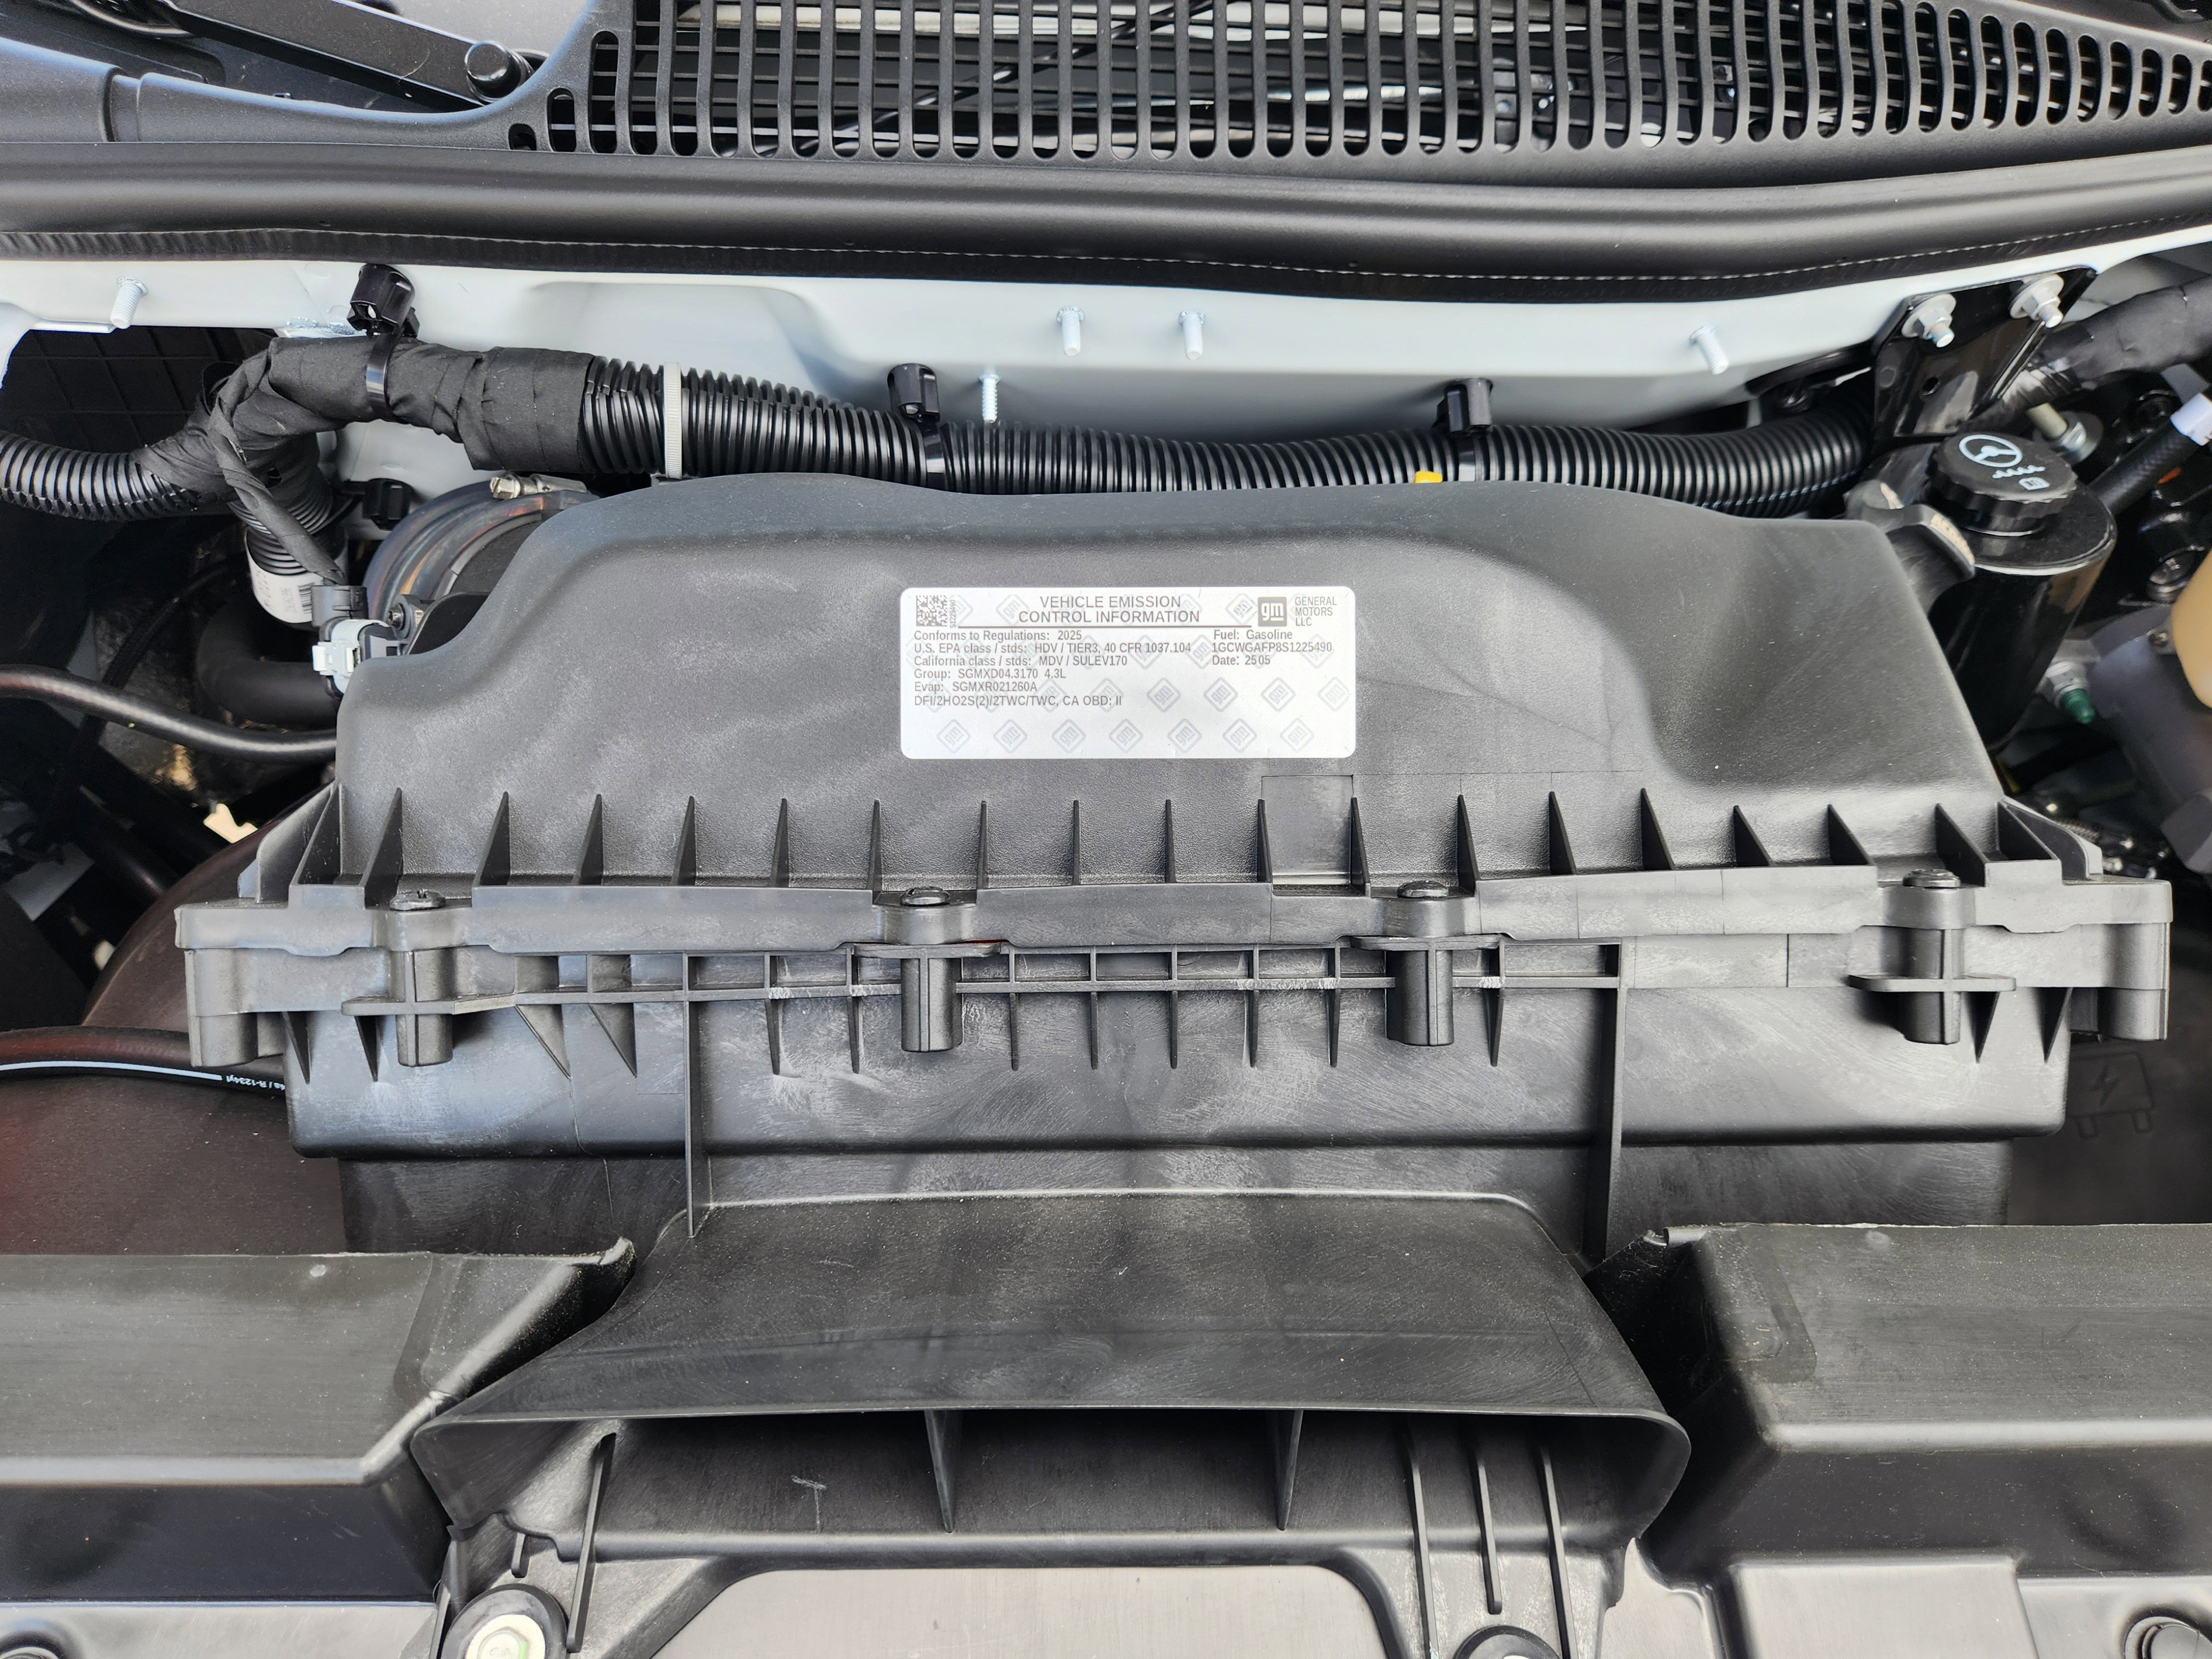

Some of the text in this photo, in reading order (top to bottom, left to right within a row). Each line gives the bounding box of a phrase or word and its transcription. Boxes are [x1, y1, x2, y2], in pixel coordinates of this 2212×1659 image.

[1040, 596, 1181, 608] VEHICLE EMISSION
[1295, 596, 1337, 606] GENERAL
[1019, 611, 1199, 623] CONTROL INFORMATION
[1295, 607, 1333, 616] MOTORS
[1295, 617, 1312, 627] LLC
[914, 630, 1082, 643] Conforms to Regulations: 2025
[1214, 629, 1293, 639] Fuel: Gasoline
[915, 643, 1191, 655] U.S. EPA class / stds: HDV / TIER3, 40 CFR 1037.104
[1212, 642, 1332, 653] 1GCWGAFP8S1225490
[914, 655, 1128, 666] California class / stds: MDV / SULEV170
[1212, 655, 1239, 665] Date:
[914, 669, 1066, 681] Group: SGMXD04.3170 4.3L
[915, 682, 1037, 694] Evap: SGMXR021260A
[1063, 696, 1079, 706] CA
[1084, 696, 1112, 706] OBD:
